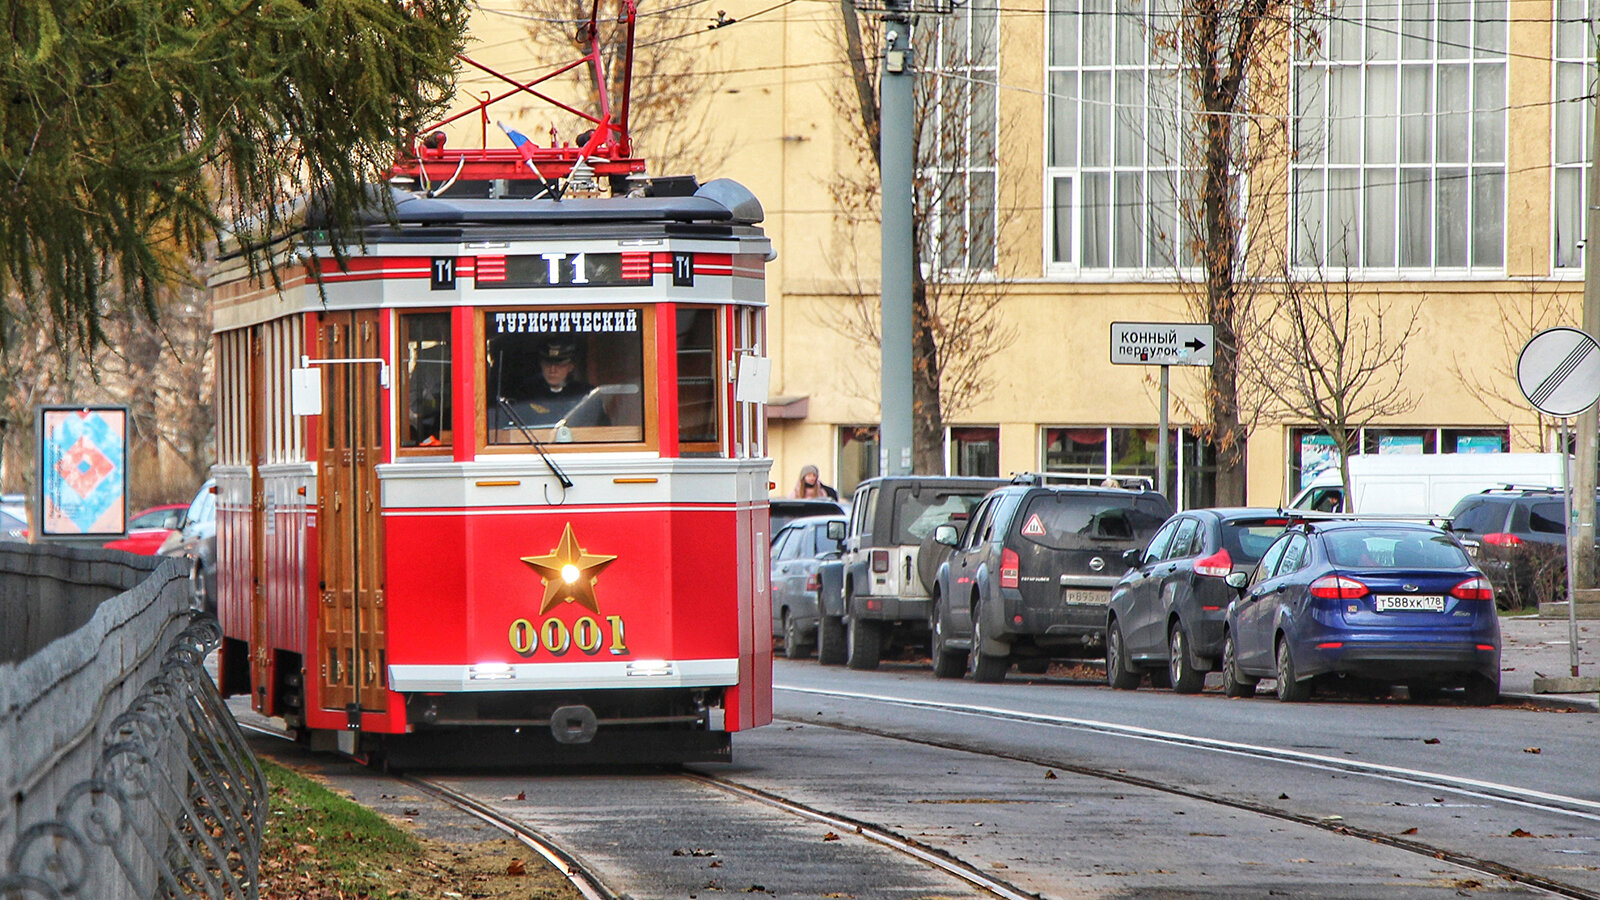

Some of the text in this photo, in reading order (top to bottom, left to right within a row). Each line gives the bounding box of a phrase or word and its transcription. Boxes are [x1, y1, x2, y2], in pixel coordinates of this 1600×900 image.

[435, 259, 452, 282] Т1
[540, 252, 590, 285] Т1
[675, 255, 690, 279] Т1
[495, 309, 637, 333] ТУРИСТИЧЕСКИЙ
[1121, 329, 1177, 344] КОННЫЙ
[1119, 346, 1178, 358] переулок
[1424, 597, 1441, 606] 178
[508, 615, 630, 657] 0001
